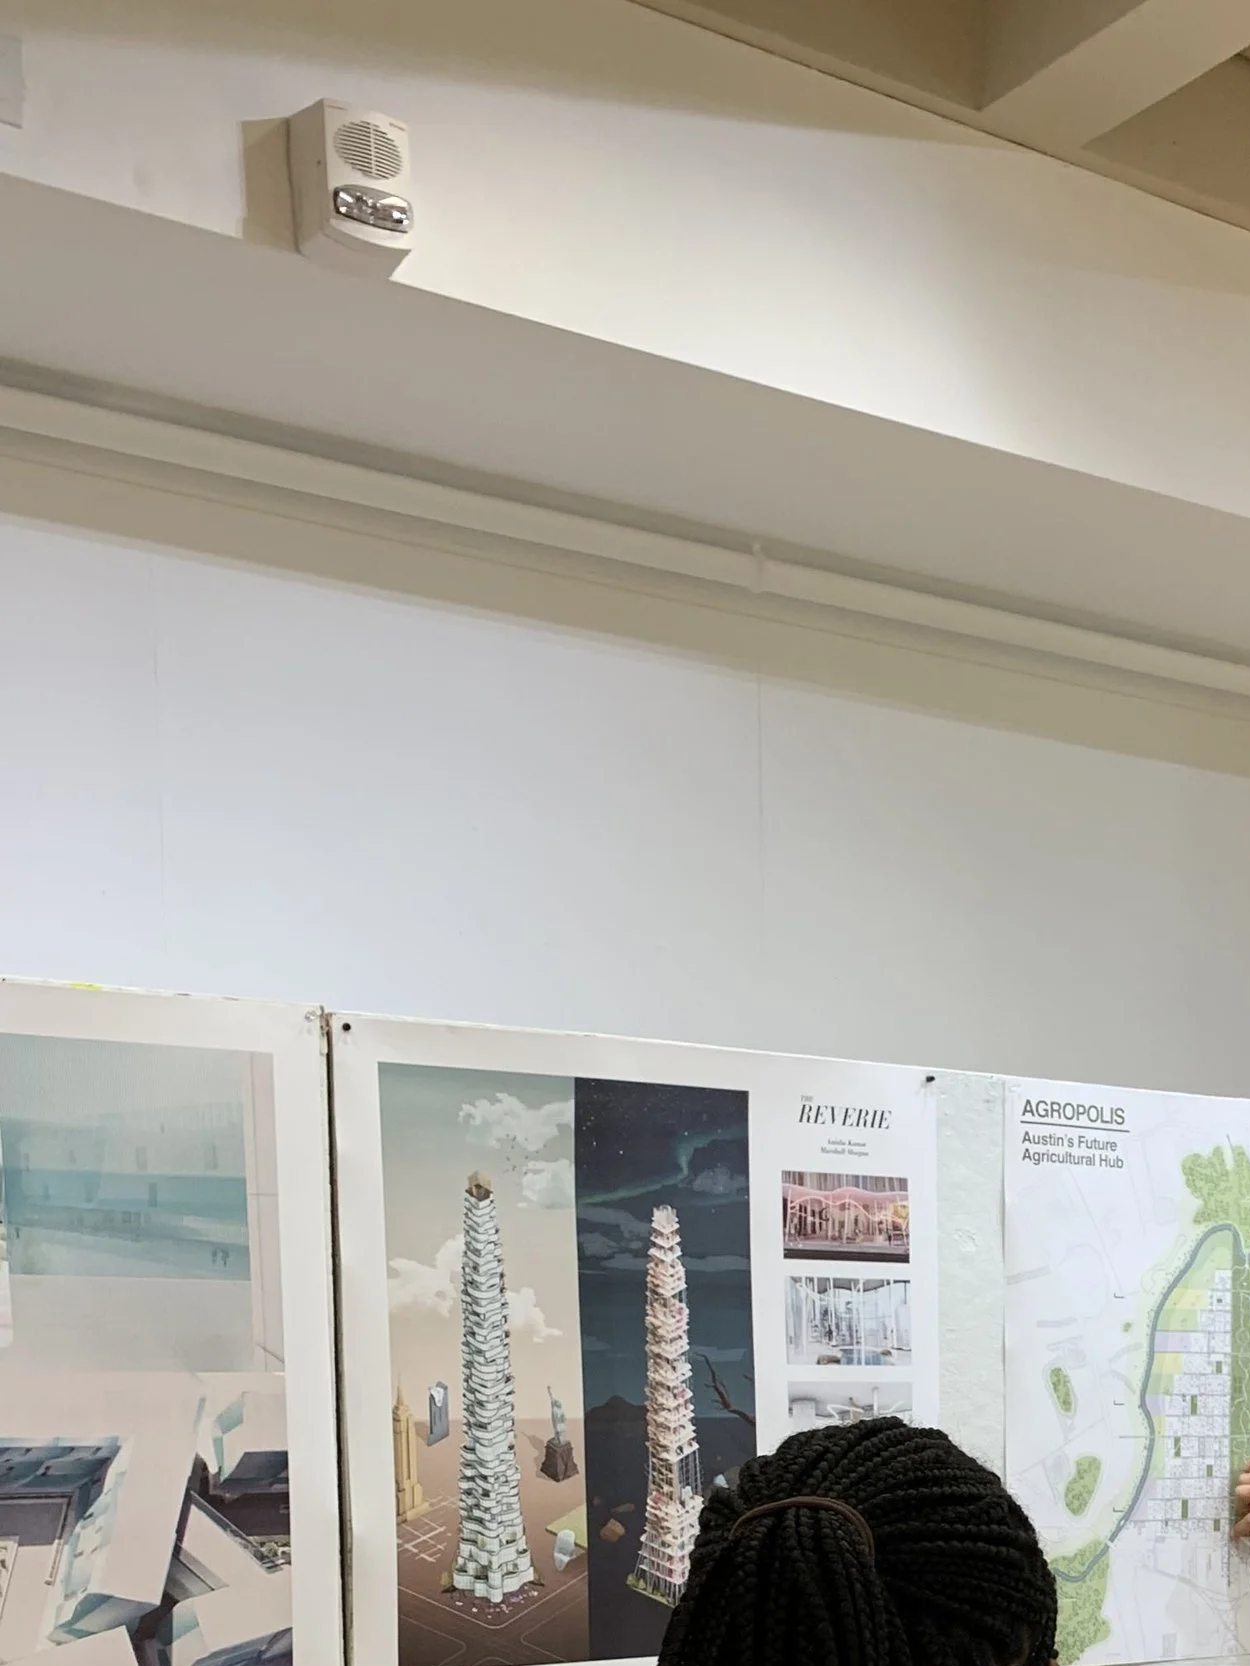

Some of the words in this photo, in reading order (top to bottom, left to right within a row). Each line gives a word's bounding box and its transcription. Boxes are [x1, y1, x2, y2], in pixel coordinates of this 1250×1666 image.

[798, 1103, 893, 1129] REVERIE
[1021, 1098, 1126, 1126] AGROPOLIS
[1021, 1130, 1075, 1149] Austin's
[1077, 1135, 1118, 1152] Future
[1022, 1148, 1096, 1167] Agricultural
[1099, 1153, 1125, 1169] Hub
